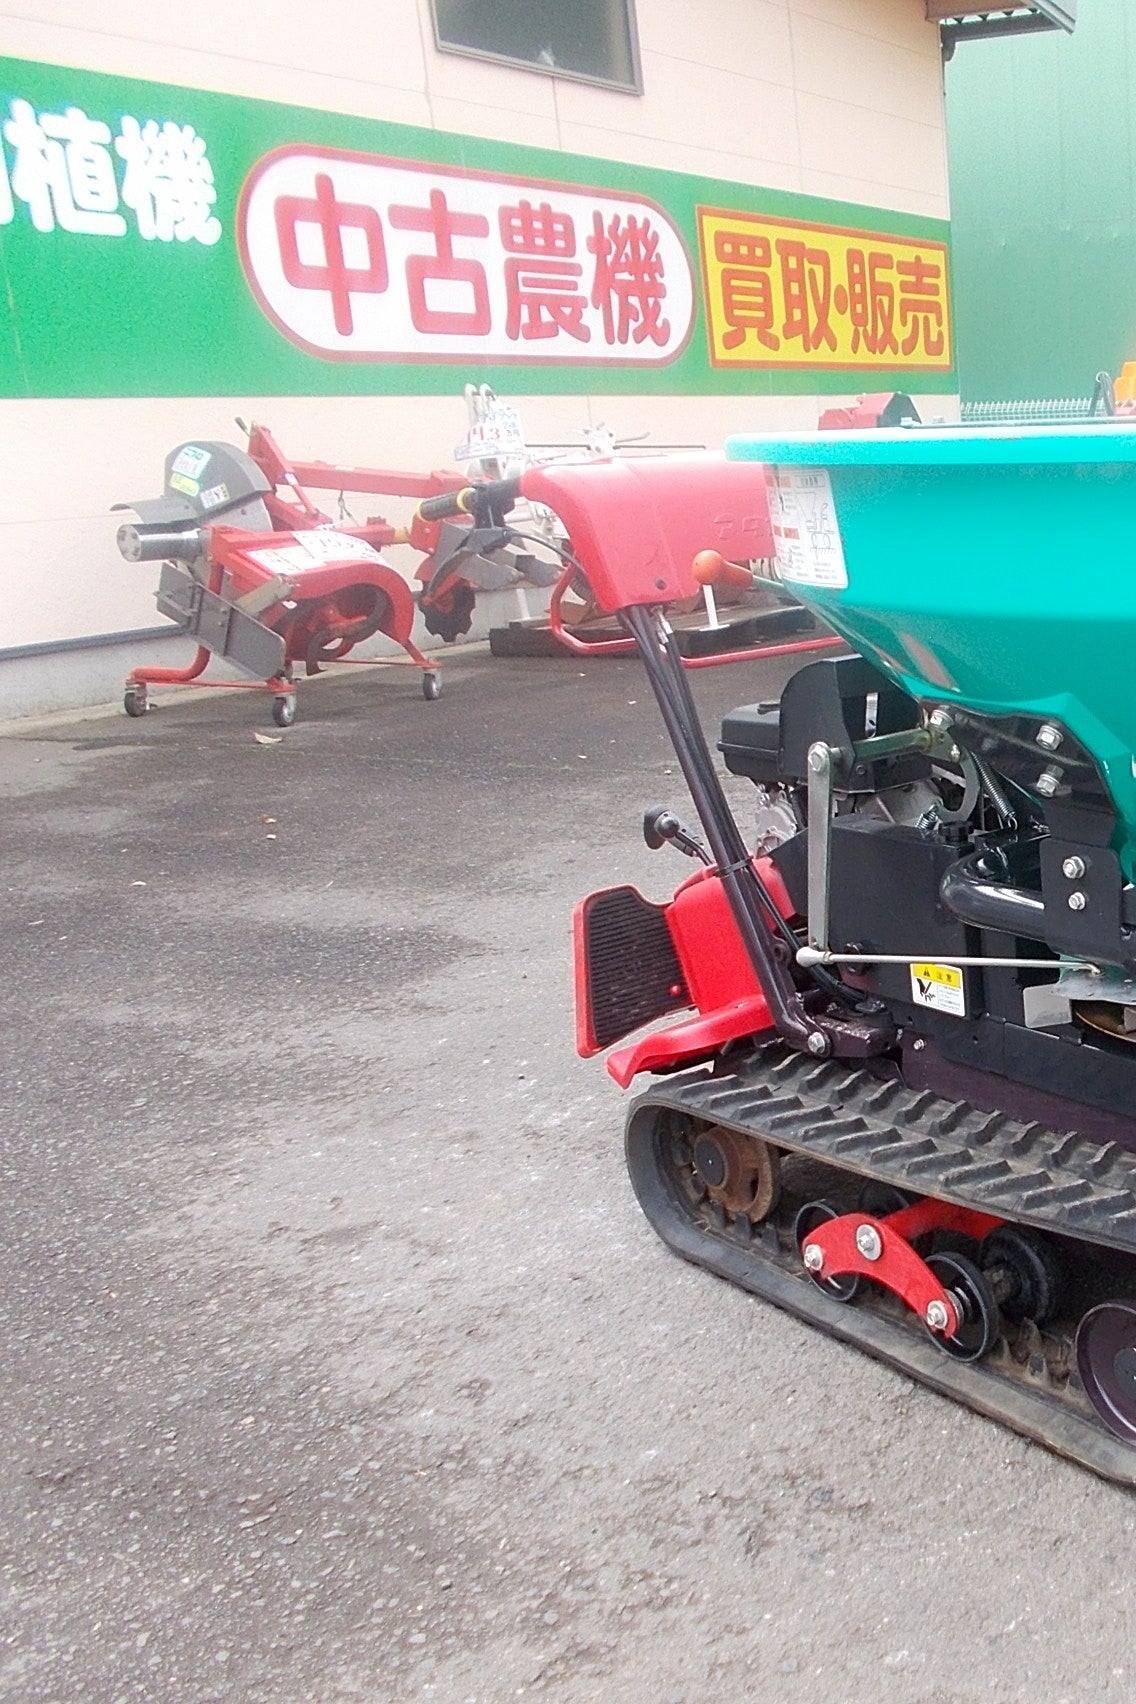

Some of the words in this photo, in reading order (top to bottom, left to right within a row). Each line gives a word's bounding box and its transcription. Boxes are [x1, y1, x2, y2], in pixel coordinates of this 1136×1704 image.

[0, 97, 222, 246] 植機
[273, 172, 671, 347] 中古農機
[713, 229, 943, 357] 買取・販売
